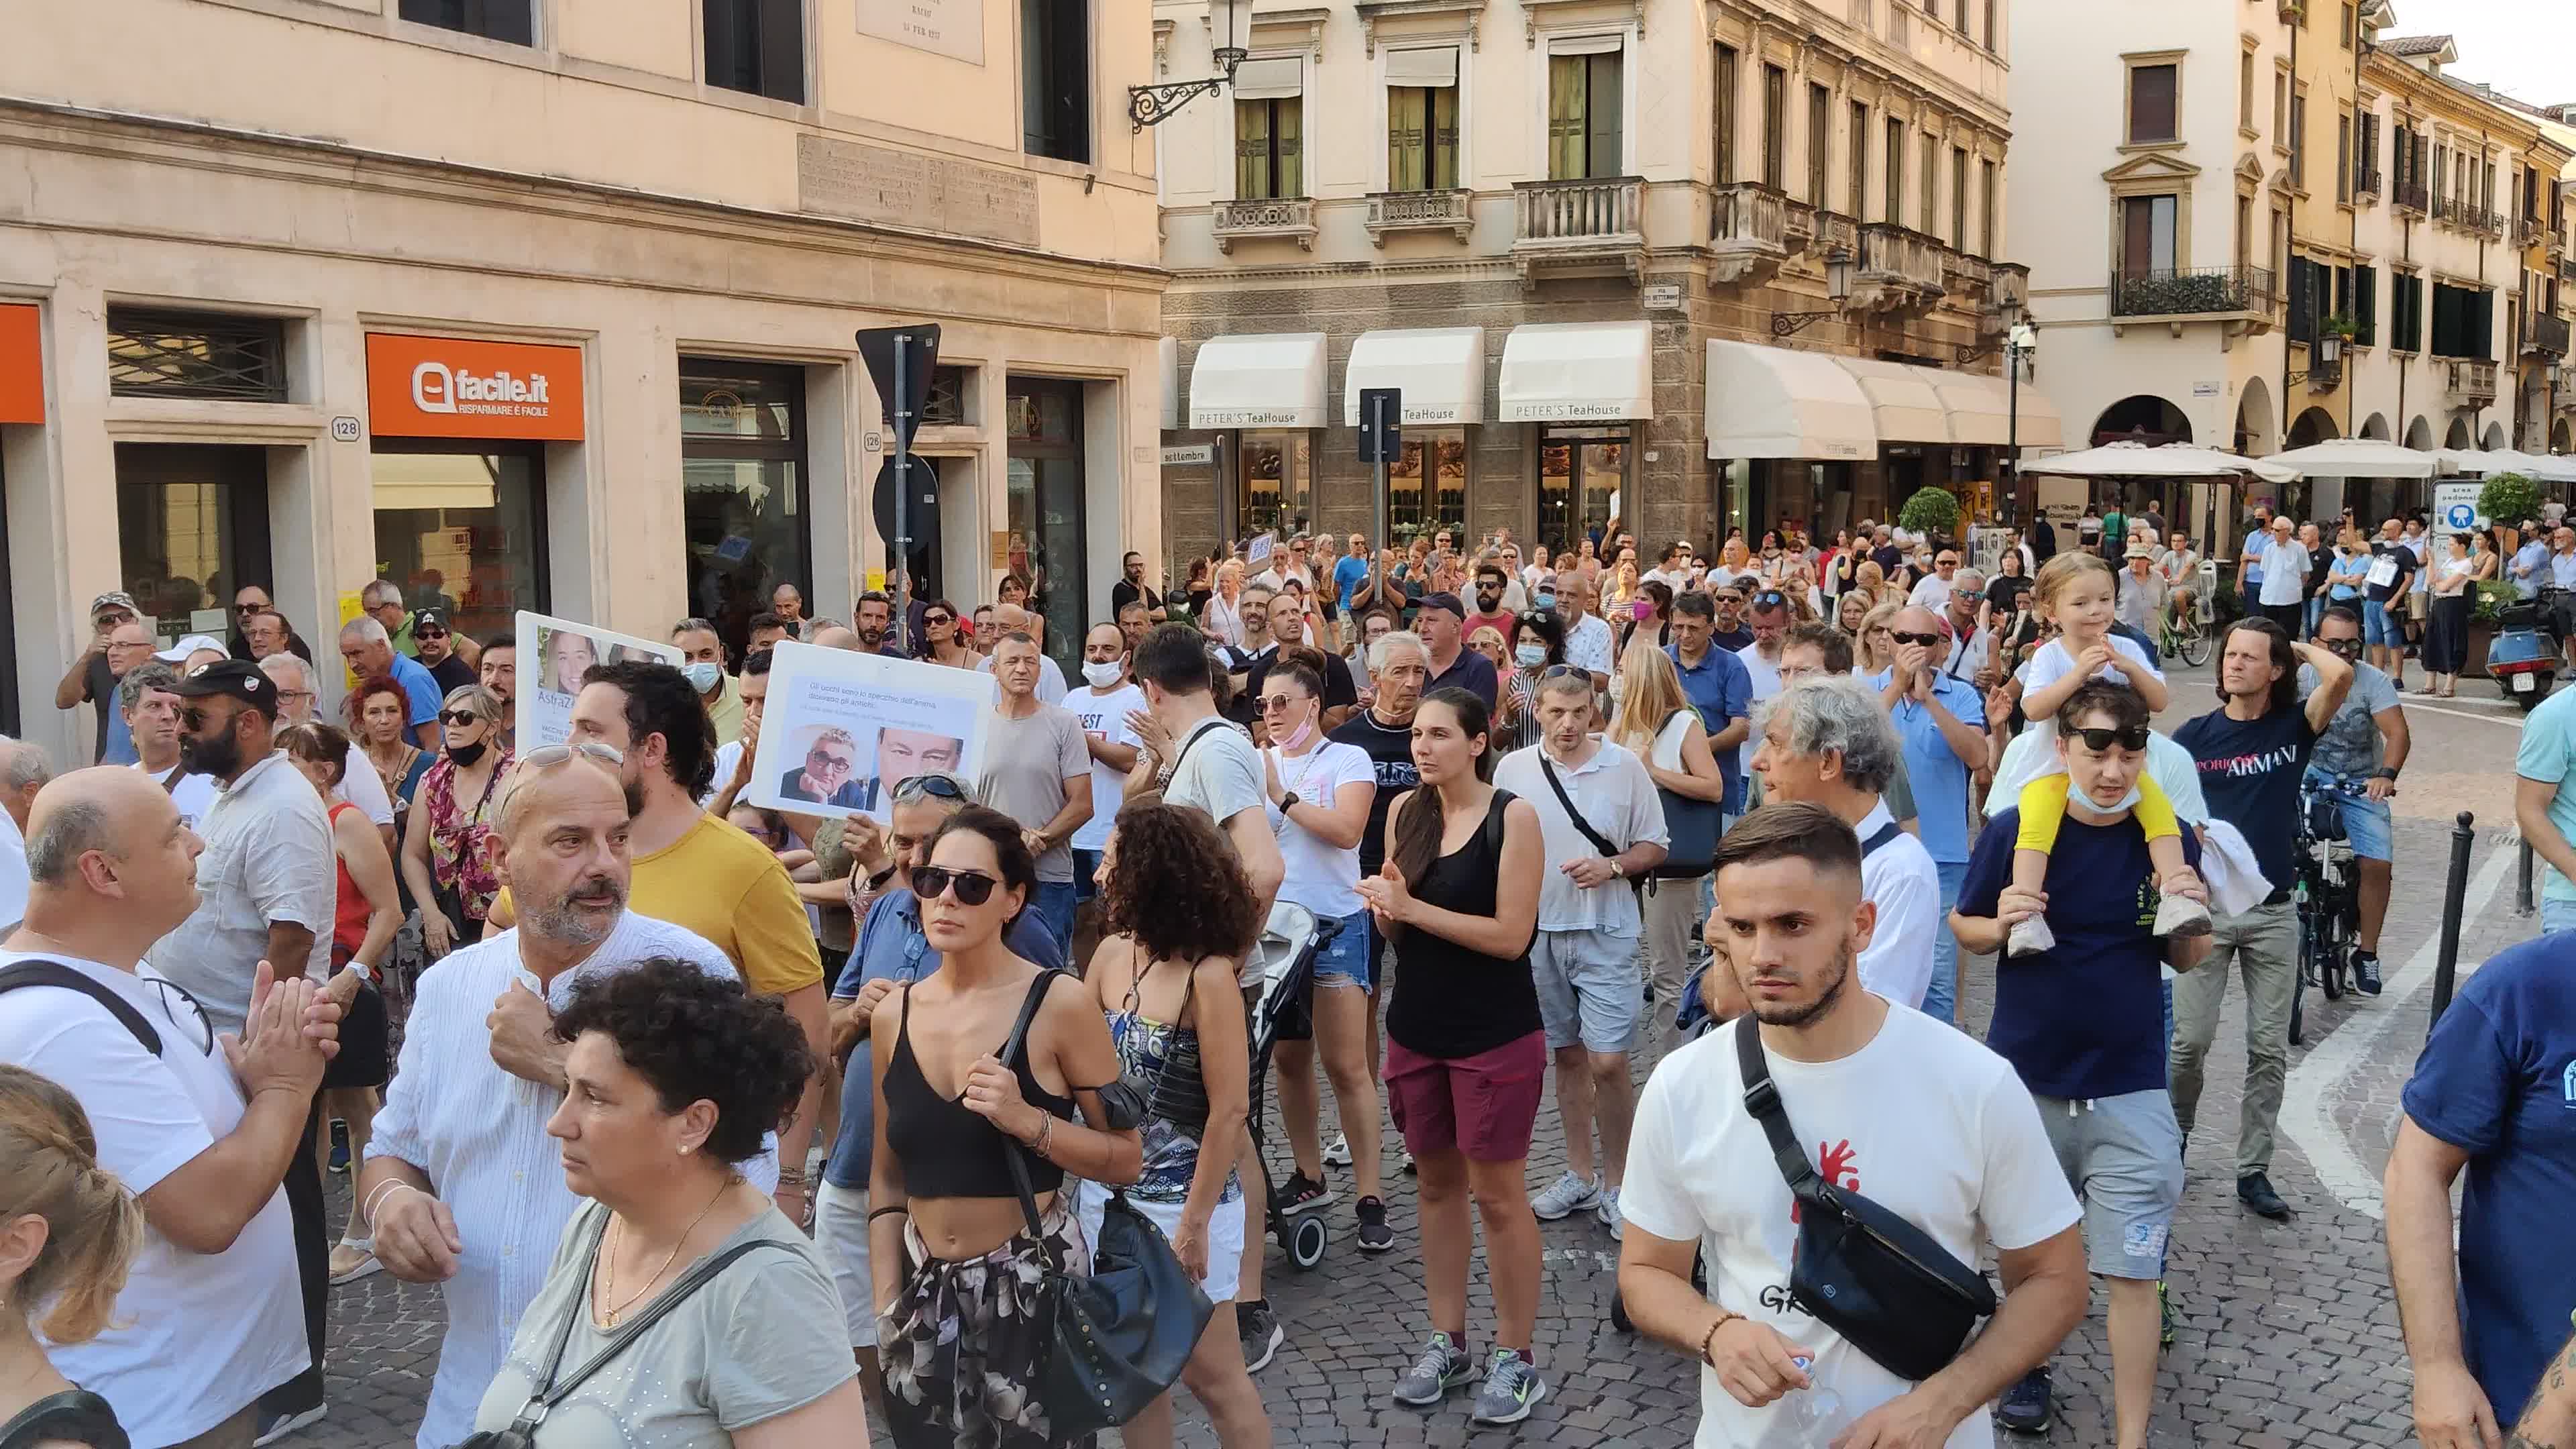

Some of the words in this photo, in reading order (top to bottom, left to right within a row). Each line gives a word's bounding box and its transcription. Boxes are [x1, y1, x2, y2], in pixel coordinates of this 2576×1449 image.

[455, 370, 549, 402] facile.it
[459, 404, 513, 415] RISPARMIARE
[522, 406, 548, 416] FACILE
[1404, 409, 1454, 419] TeaHouse
[1516, 405, 1564, 417] PETER'S
[1568, 405, 1621, 415] TeaHouse
[1199, 413, 1243, 424] PETER'S
[1247, 413, 1296, 423] TeaHouse
[337, 423, 356, 435] 128
[1165, 451, 1205, 462] settembre
[1077, 714, 1104, 729] EST
[1759, 1283, 1814, 1318] GR
